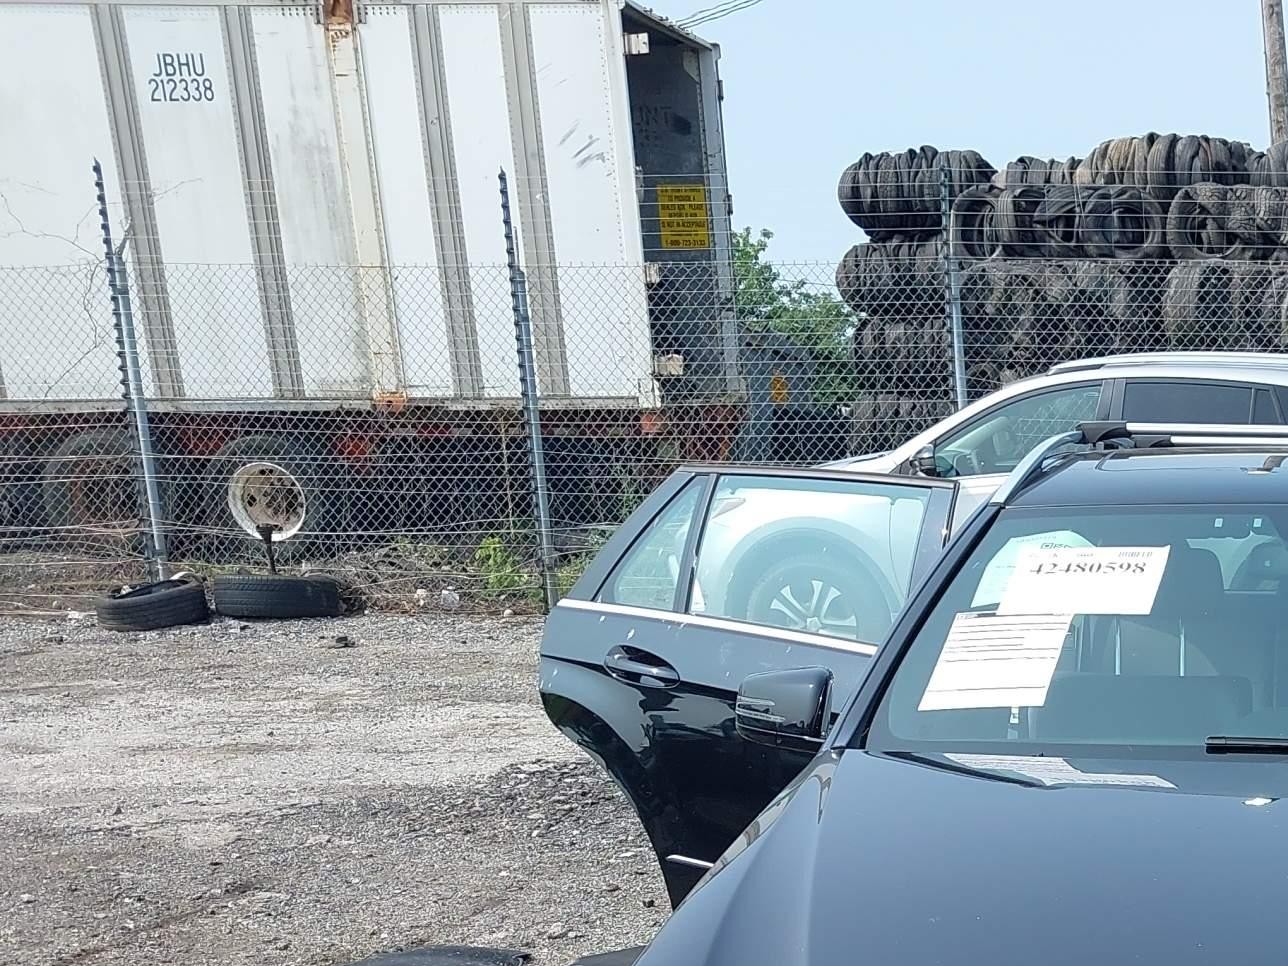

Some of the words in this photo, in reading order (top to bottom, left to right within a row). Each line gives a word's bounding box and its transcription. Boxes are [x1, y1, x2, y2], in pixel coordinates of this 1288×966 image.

[153, 53, 204, 77] JBHU
[148, 78, 214, 102] 212338
[1030, 562, 1147, 575] 42480598
